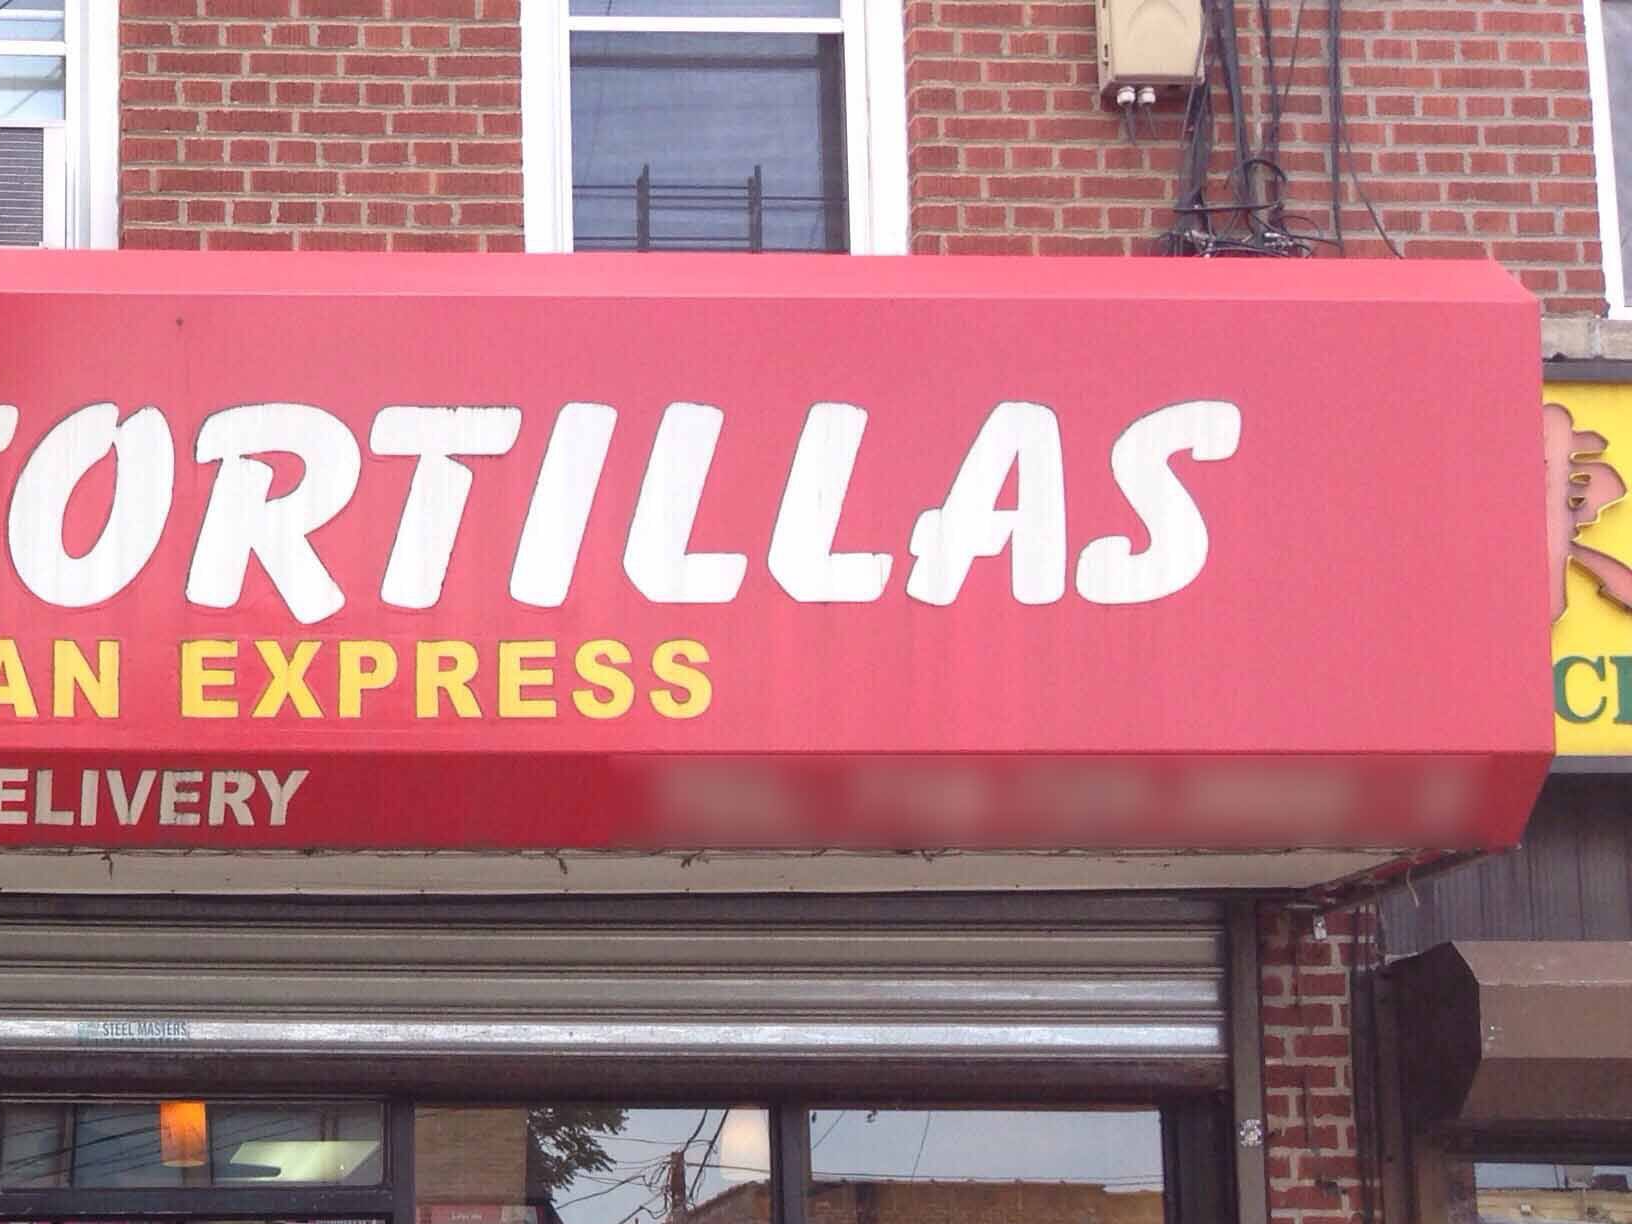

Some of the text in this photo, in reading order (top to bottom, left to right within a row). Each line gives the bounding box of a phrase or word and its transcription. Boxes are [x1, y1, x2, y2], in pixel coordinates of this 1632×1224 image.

[180, 638, 714, 719] EXPRESS
[103, 1021, 186, 1037] STEEL MASTERS
